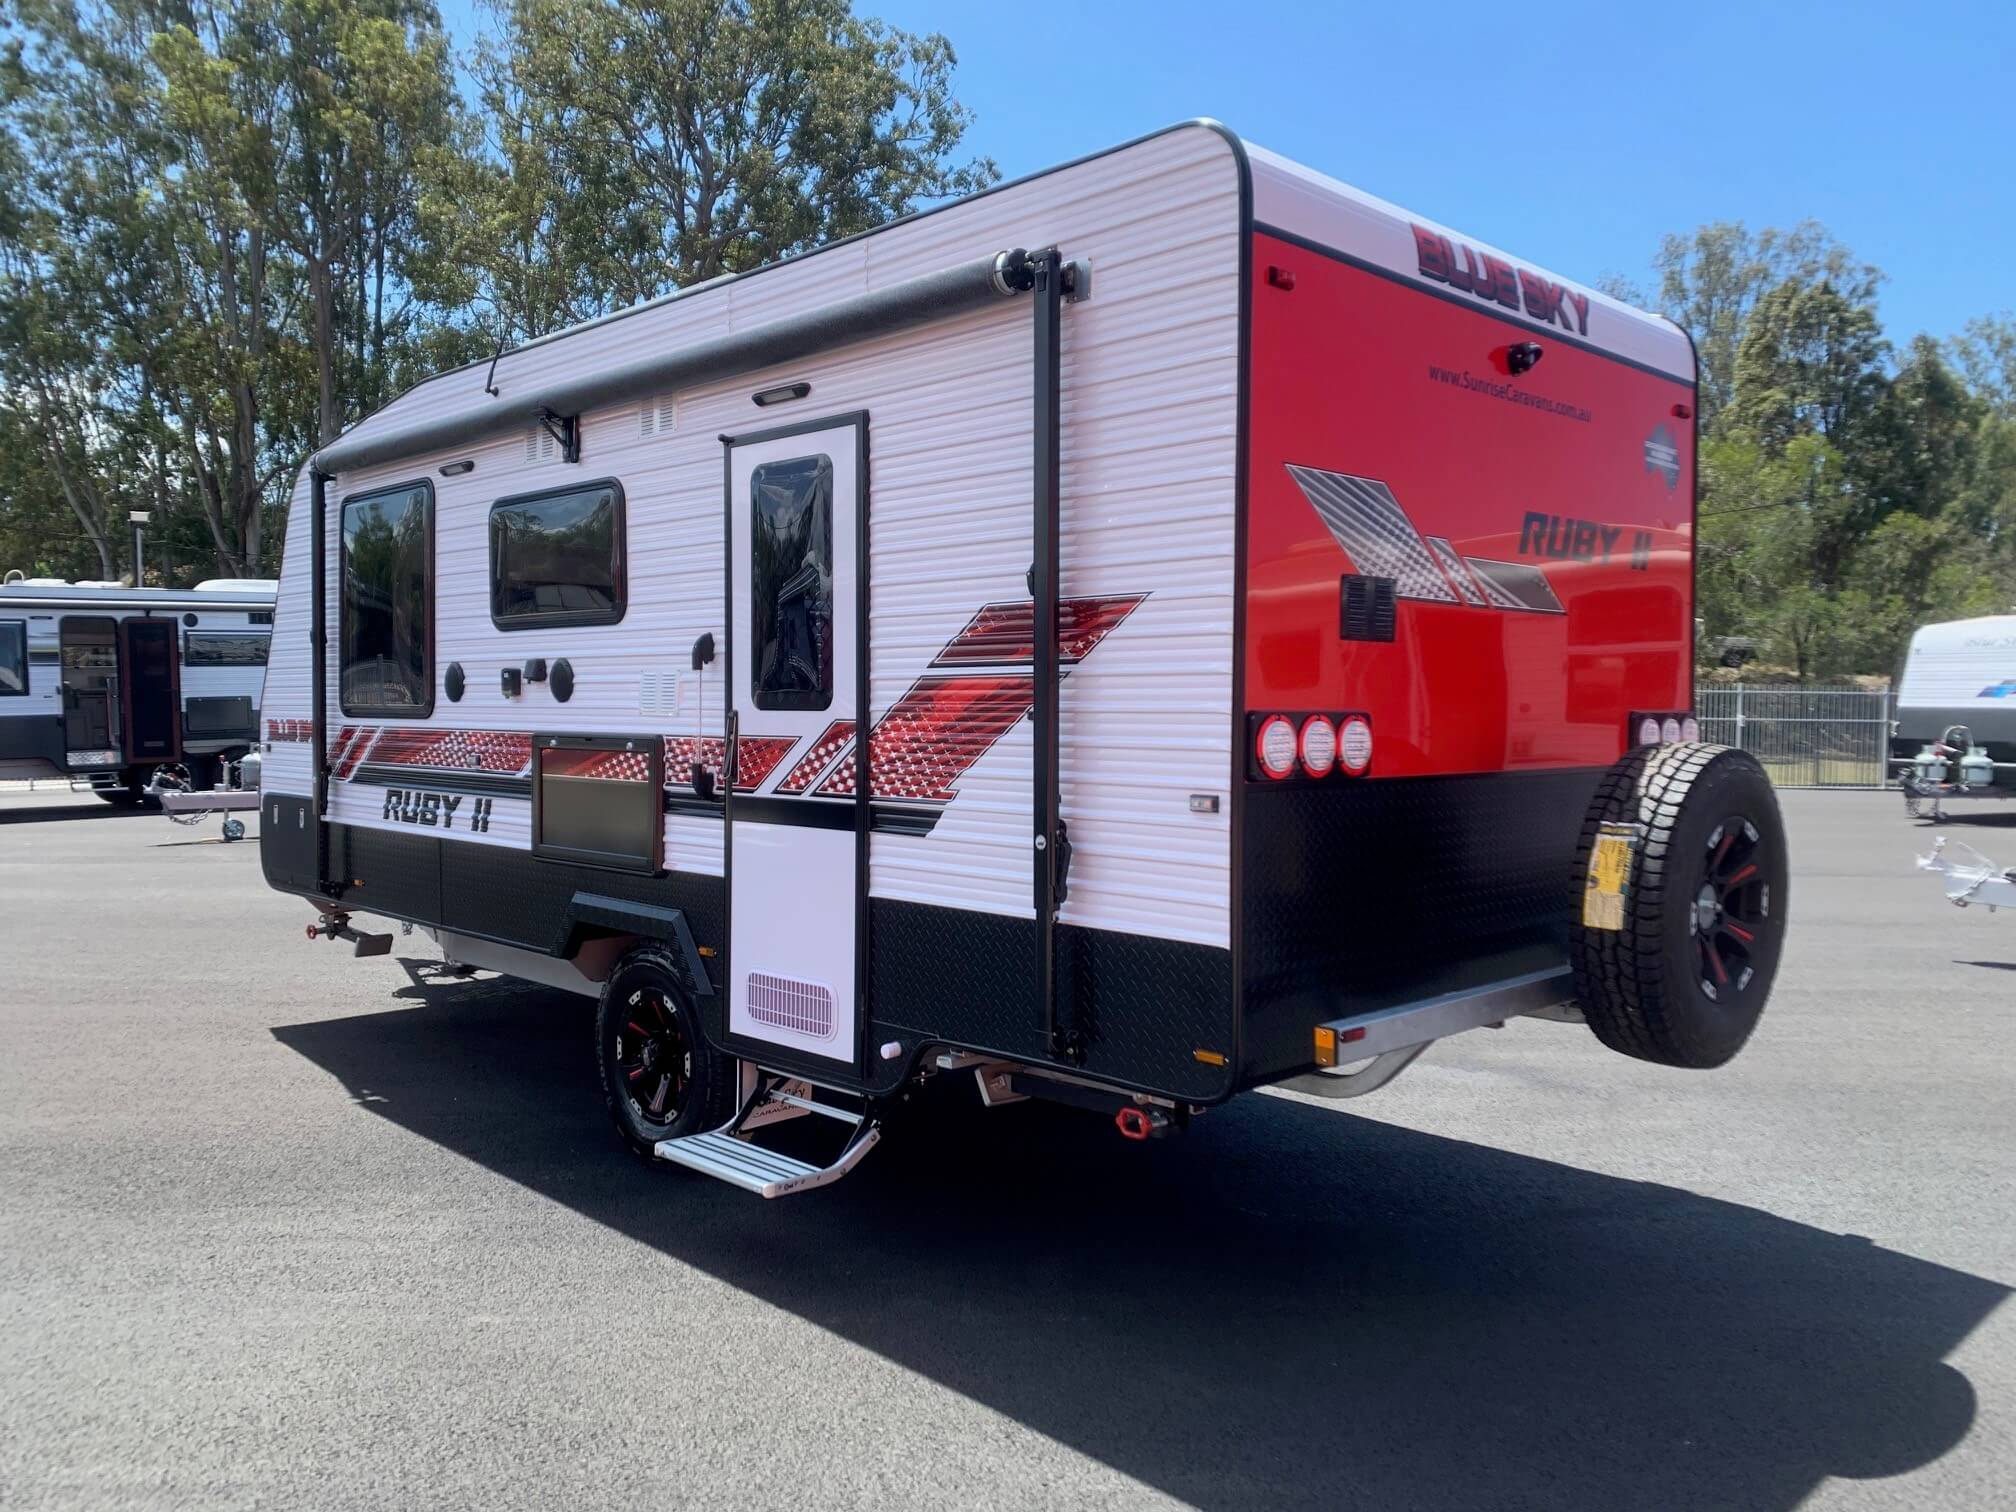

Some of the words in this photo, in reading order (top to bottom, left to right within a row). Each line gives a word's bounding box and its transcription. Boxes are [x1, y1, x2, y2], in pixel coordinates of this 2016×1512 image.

[1428, 364, 1592, 423] www.SunriseCaravans.com.au
[1518, 511, 1621, 565] RUBY
[1631, 530, 1653, 571] II
[383, 789, 463, 828] RUBY
[471, 798, 492, 832] II
